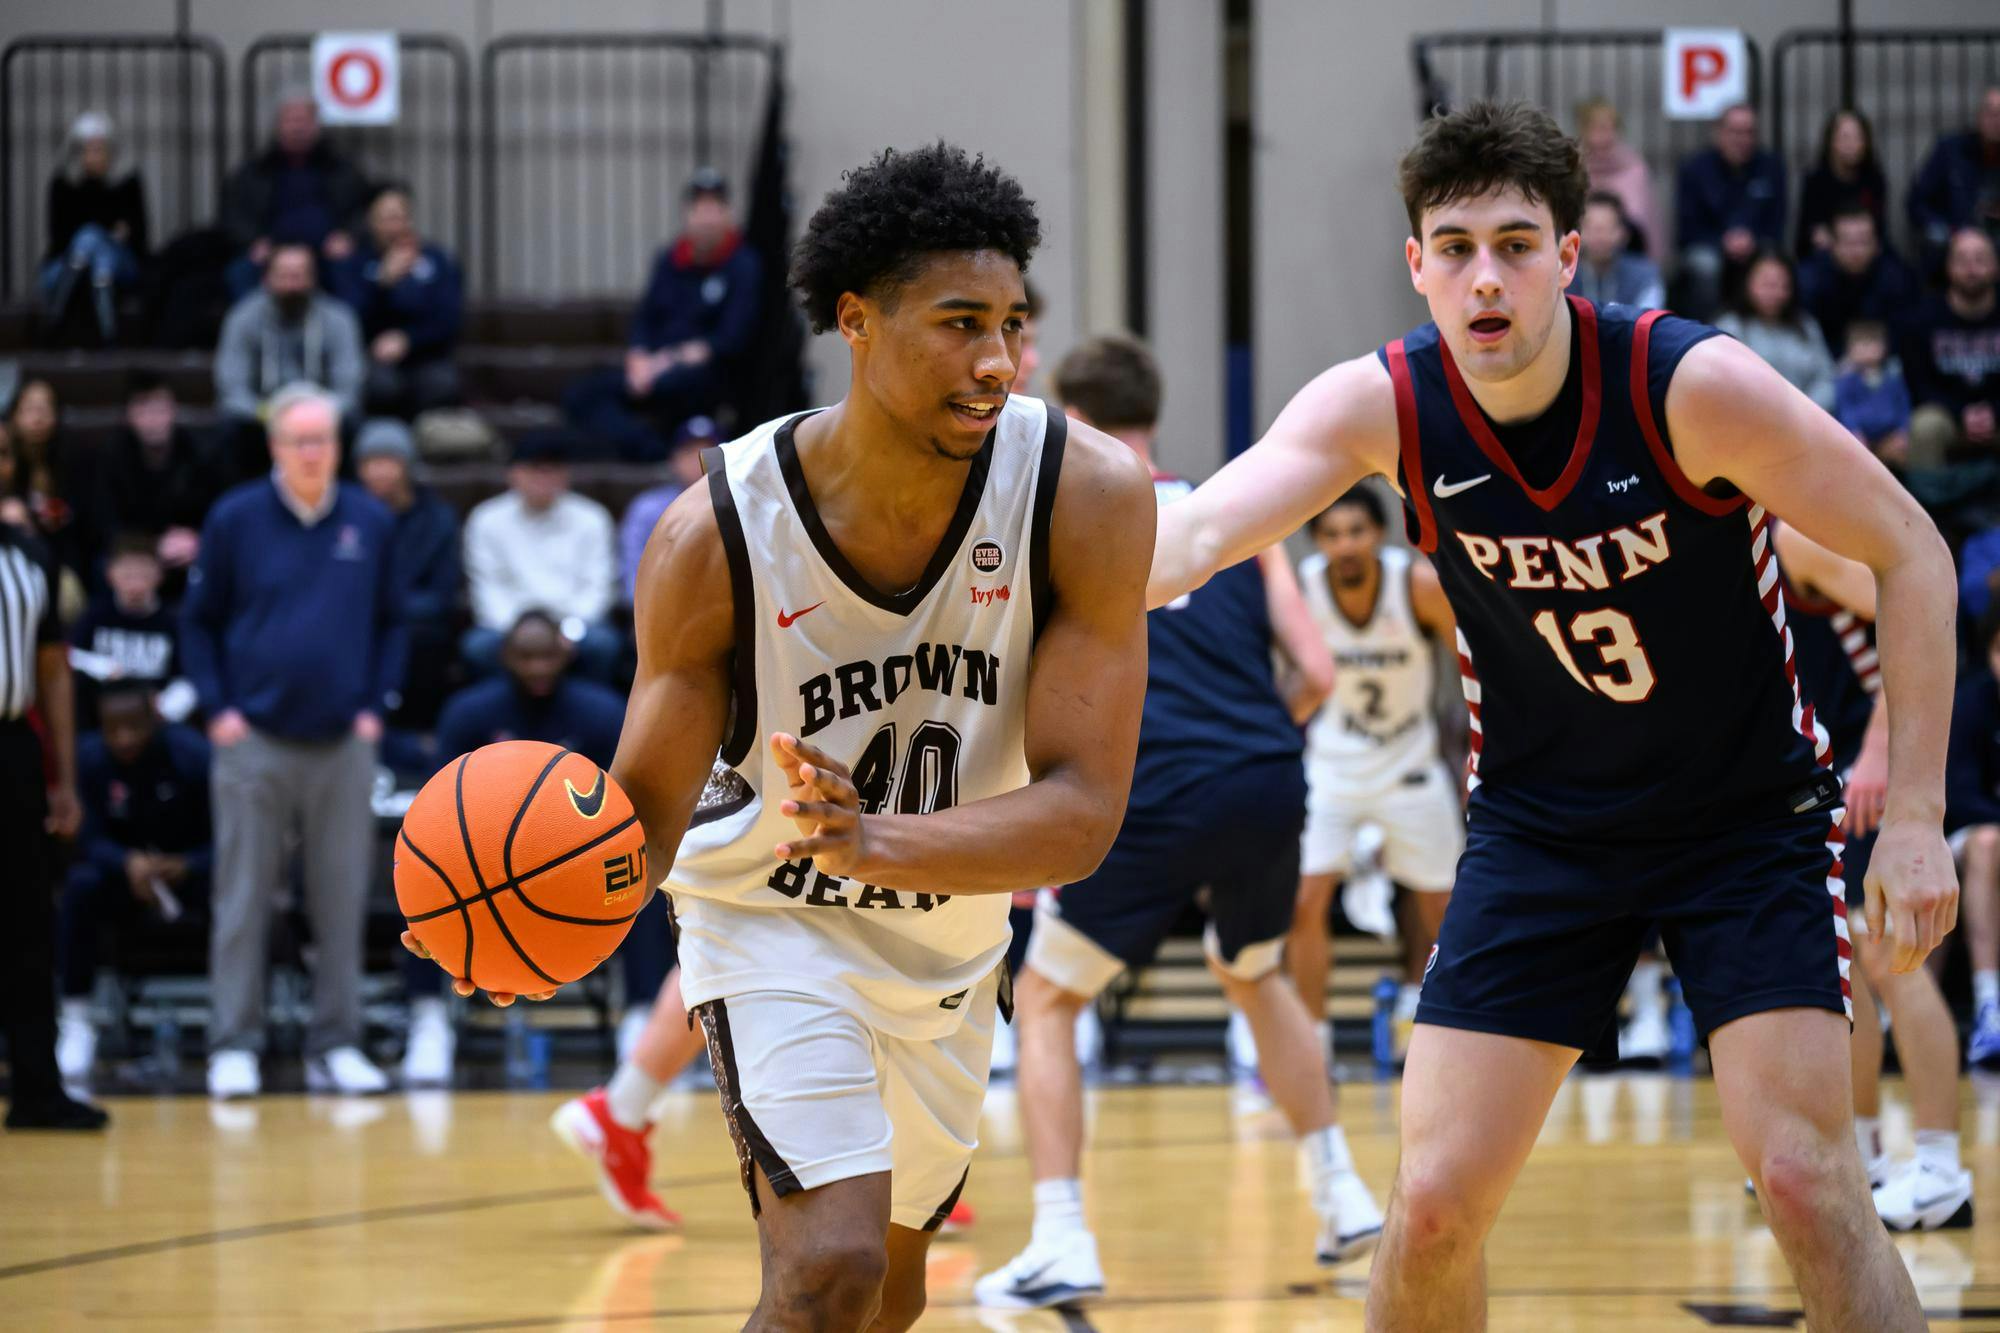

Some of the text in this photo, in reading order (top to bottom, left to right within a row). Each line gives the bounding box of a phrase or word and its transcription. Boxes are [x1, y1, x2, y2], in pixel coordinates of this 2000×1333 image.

[327, 50, 383, 108] O
[1681, 46, 1726, 100] P
[1607, 479, 1628, 493] Ivy
[975, 548, 999, 557] EVER
[976, 557, 1000, 566] TRUE
[1453, 509, 1671, 592] PENN
[970, 587, 994, 607] Ivy
[1532, 605, 1657, 703] 13
[799, 642, 1000, 738] BROWN
[1358, 679, 1386, 719] 2
[851, 719, 962, 815] 40
